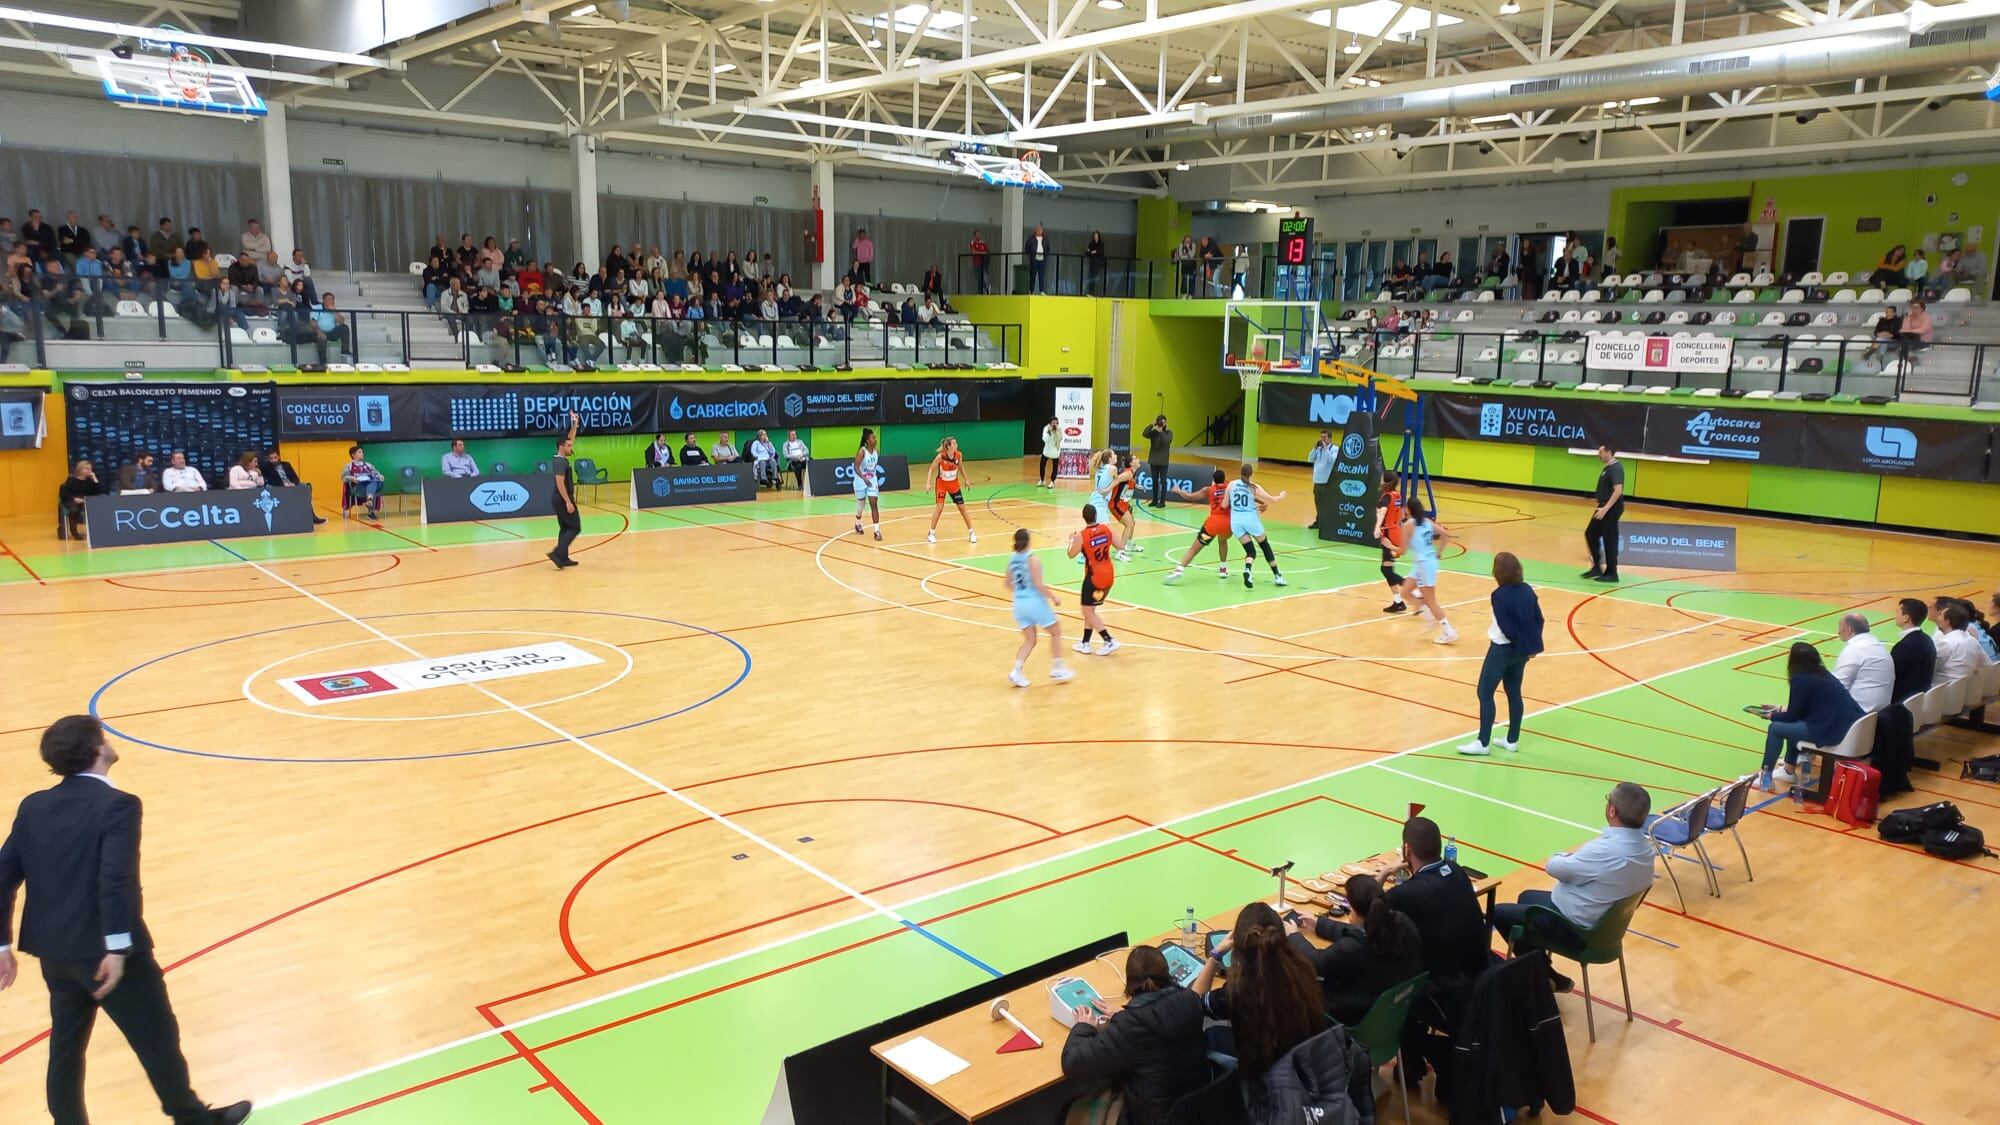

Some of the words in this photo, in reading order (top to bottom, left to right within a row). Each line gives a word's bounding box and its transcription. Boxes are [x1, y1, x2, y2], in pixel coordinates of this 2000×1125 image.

[1283, 221, 1306, 232] 02:08
[1289, 238, 1304, 262] 13
[1595, 343, 1640, 352] CONCELLO
[1676, 342, 1727, 350] CONCELLERÍA
[1614, 352, 1634, 360] VIGO
[1680, 356, 1719, 364] DEPORTES
[92, 389, 117, 397] CELTA
[119, 387, 176, 396] BALONCESTO
[177, 387, 222, 396] FEMENINO
[806, 394, 836, 404] SAVINO
[837, 393, 852, 403] DEL
[854, 392, 875, 402] BENE
[523, 392, 631, 412] DEPUTACIÓN
[904, 388, 959, 413] quattro
[287, 403, 350, 414] CONCELLO
[1507, 407, 1556, 422] XUNTA
[295, 415, 311, 425] DE
[315, 414, 344, 424] VIGO
[1686, 411, 1761, 431] Autocares
[1505, 421, 1524, 435] DE
[1528, 423, 1586, 440] GALICIA
[1691, 425, 1760, 446] Troncoso
[1338, 462, 1369, 475] Recalvi
[673, 477, 700, 486] SAVINO
[701, 475, 716, 484] DEL
[717, 474, 737, 483] BENE
[481, 489, 518, 507] Zorka
[1233, 493, 1249, 507] 20
[1629, 535, 1668, 545] SAVINO
[1671, 537, 1693, 547] DEL
[1695, 538, 1725, 549] BENE
[503, 653, 540, 661] DE
[421, 656, 566, 680] CONCELLO
[429, 659, 497, 671] VIGO
